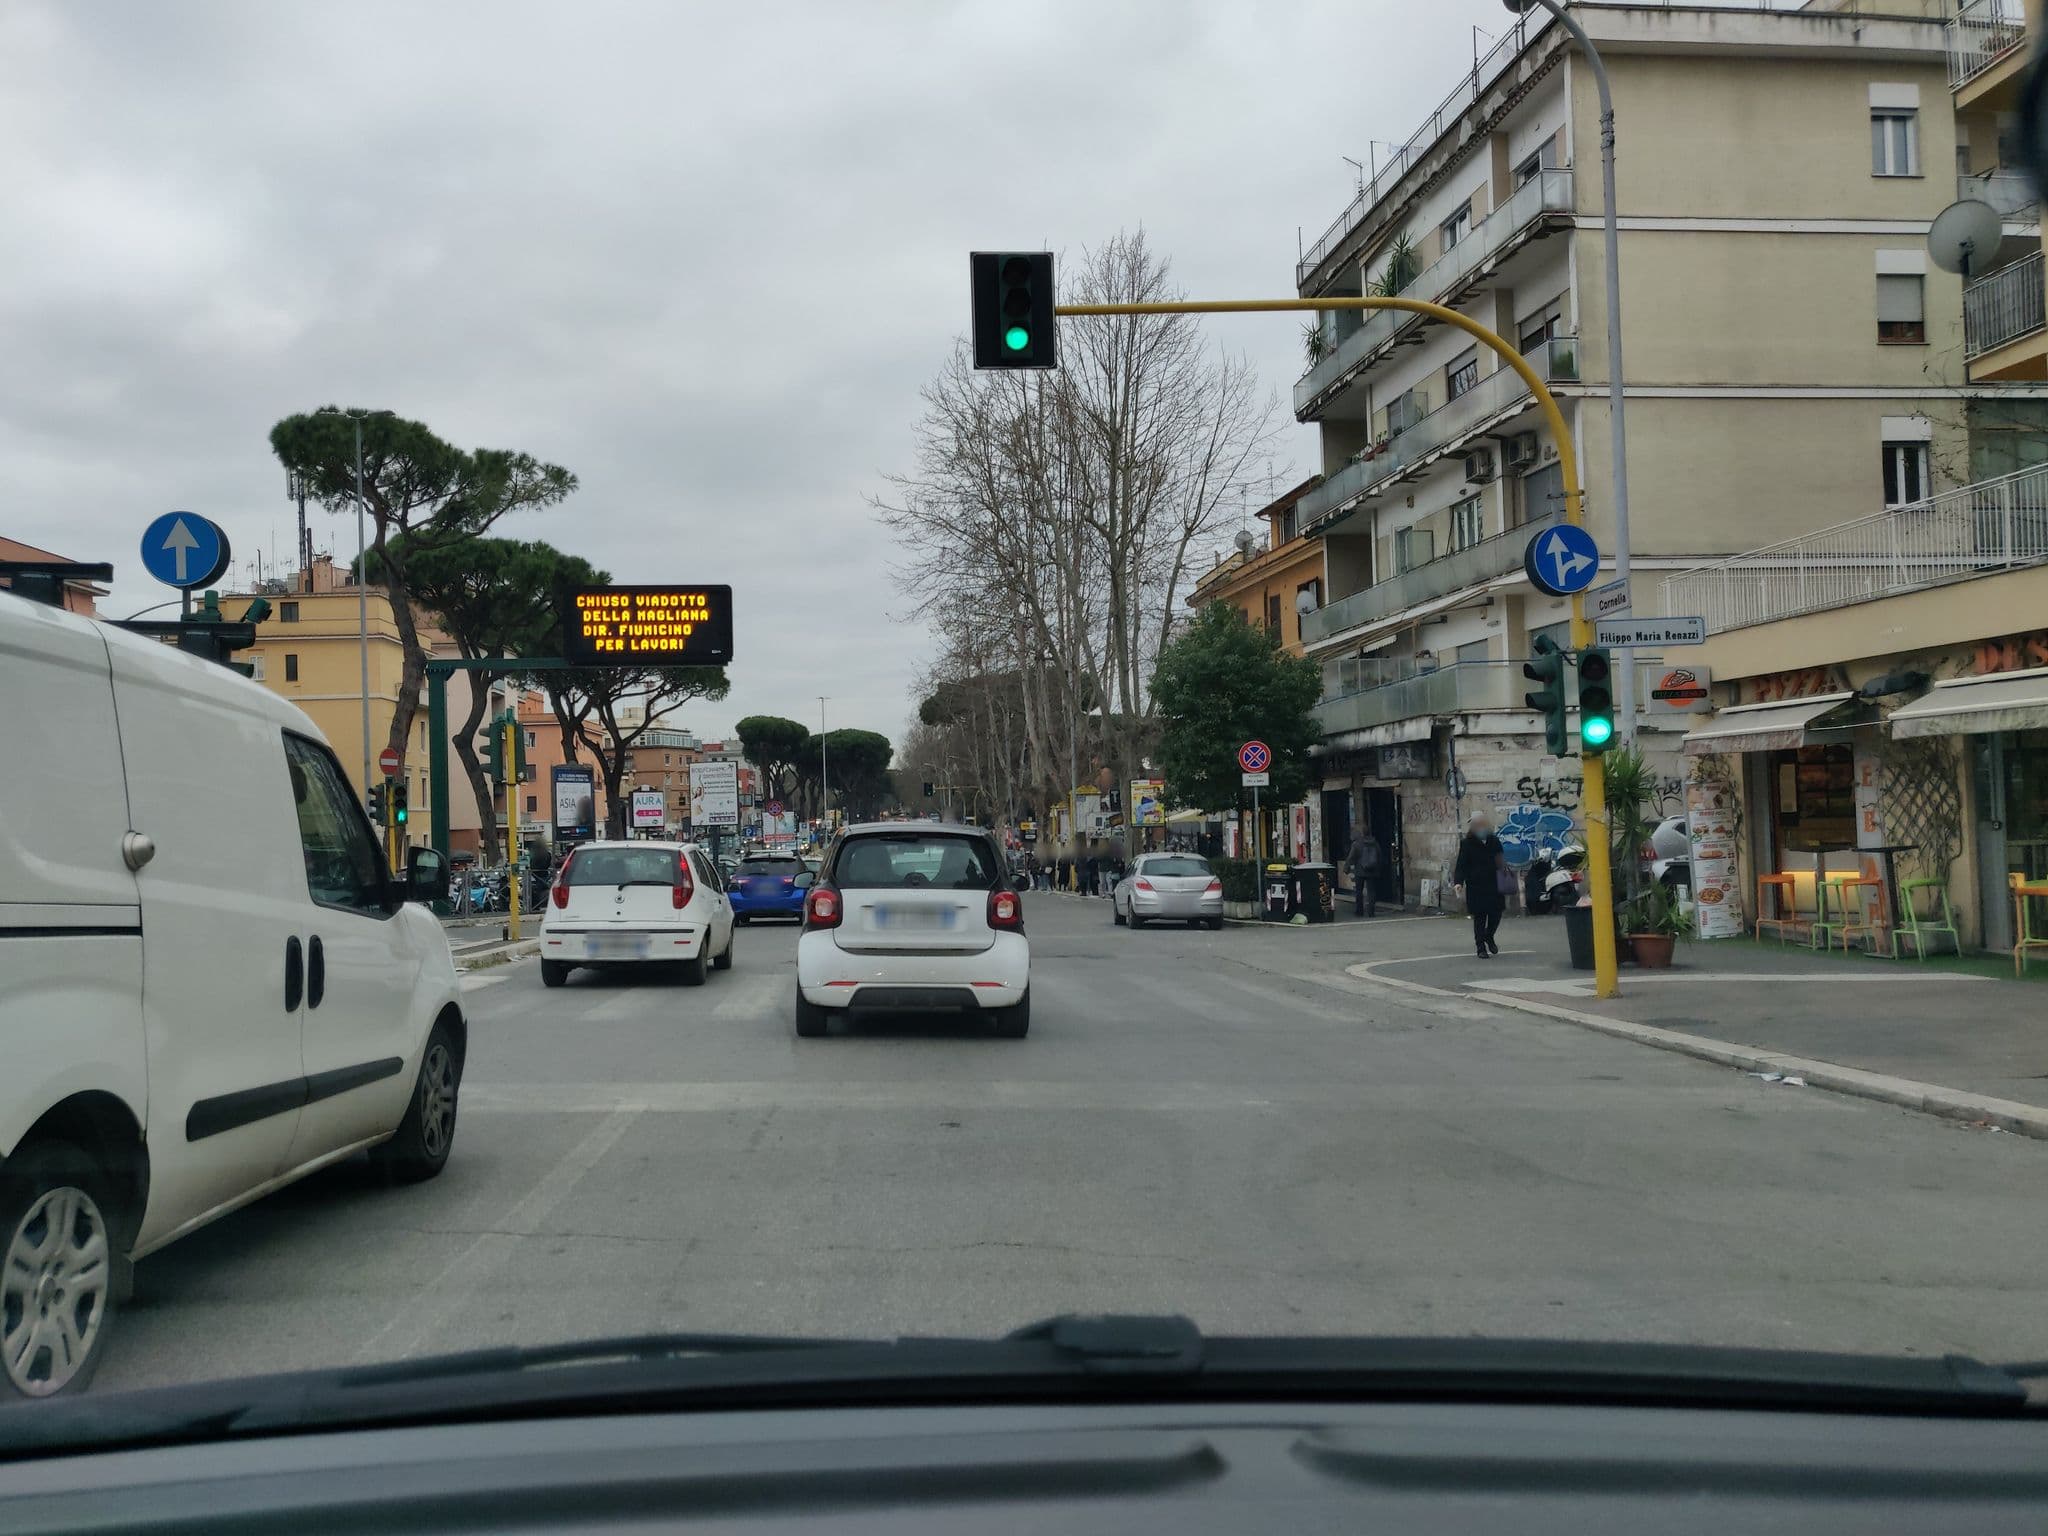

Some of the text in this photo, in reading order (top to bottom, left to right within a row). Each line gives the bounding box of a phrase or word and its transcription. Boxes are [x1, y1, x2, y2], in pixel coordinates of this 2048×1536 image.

[577, 595, 706, 607] CHIUSO VIADOTTO
[1598, 592, 1627, 612] Cornelia
[583, 610, 709, 622] DELLA MAGLIANA
[583, 624, 692, 636] DIR. FIUMICINO
[1600, 630, 1699, 644] Filippo Maria Renazzi
[596, 639, 684, 651] PER LAVORI
[559, 798, 576, 809] ASIA
[635, 796, 662, 806] AURA
